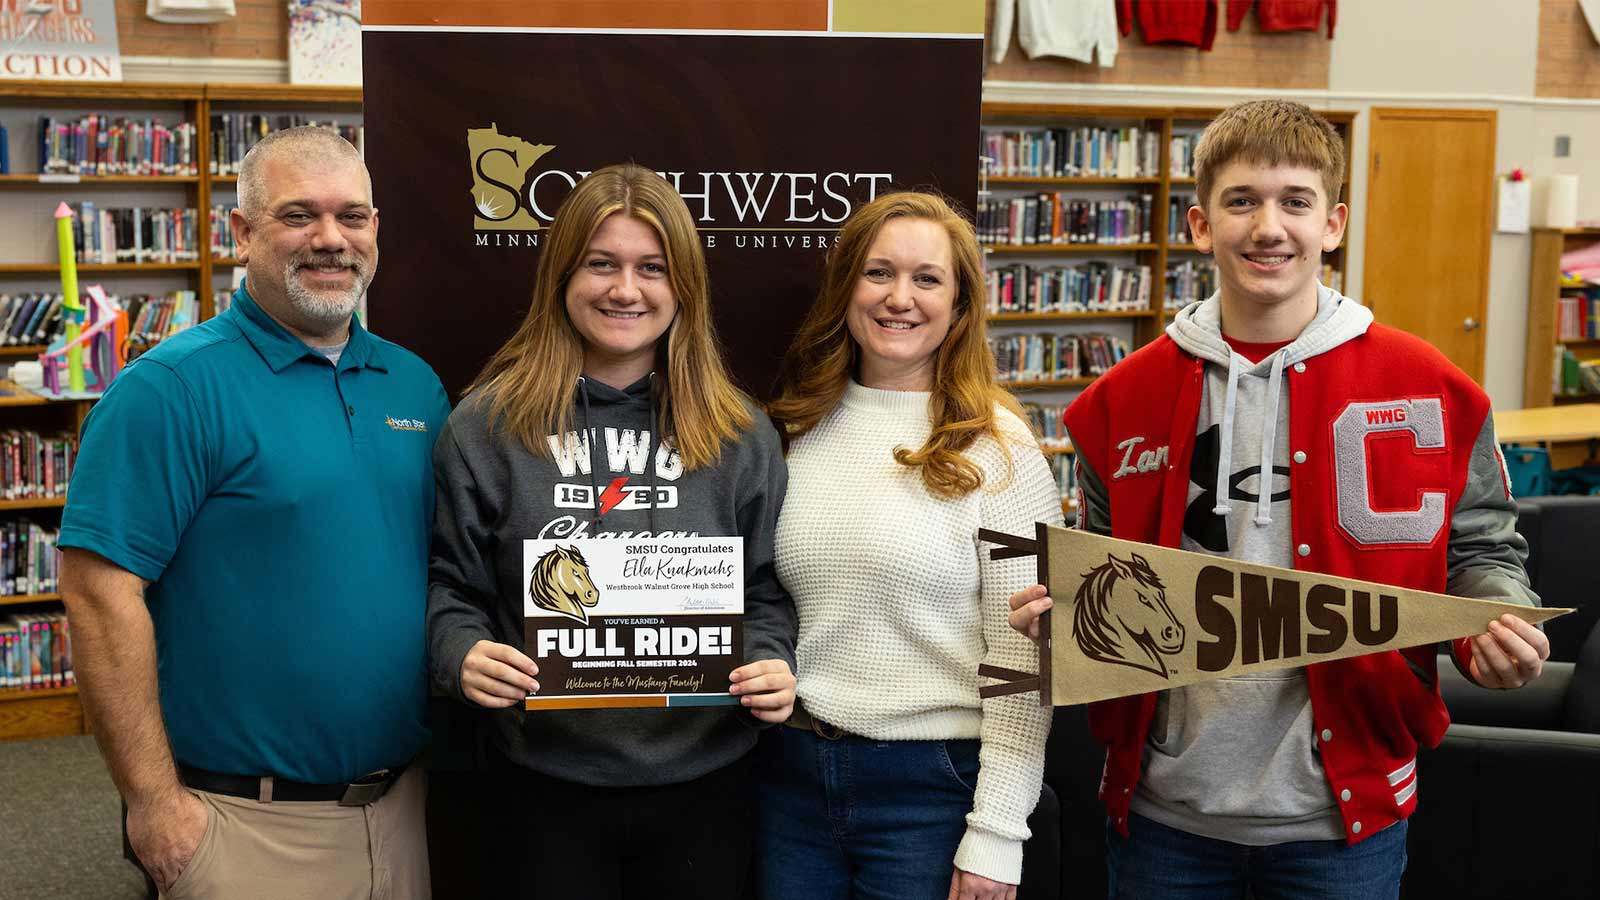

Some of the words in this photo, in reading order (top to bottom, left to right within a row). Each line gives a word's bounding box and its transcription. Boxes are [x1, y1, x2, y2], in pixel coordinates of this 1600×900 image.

[2, 53, 112, 76] CTION
[474, 148, 892, 222] SOHWEST
[735, 235, 841, 248] UNIVERS
[1366, 408, 1406, 424] WWG
[546, 426, 685, 481] WWG
[1113, 437, 1169, 478] Ian
[1332, 397, 1448, 545] C
[561, 487, 589, 503] 19
[634, 489, 670, 504] 90
[625, 545, 658, 554] SMSU
[660, 544, 734, 555] Congratulates
[623, 556, 655, 578] Ella
[656, 557, 735, 580] Knakmuhs
[606, 583, 642, 591] Westbrook
[692, 583, 709, 591] High
[1195, 565, 1399, 673] SMSU
[537, 628, 625, 658] FULL
[634, 626, 732, 656] RIDE!
[678, 659, 697, 667] 2024
[565, 676, 602, 690] Welcome
[603, 676, 610, 687] to
[612, 676, 625, 687] the
[625, 675, 668, 693] Mustang
[668, 674, 705, 692] Family!
